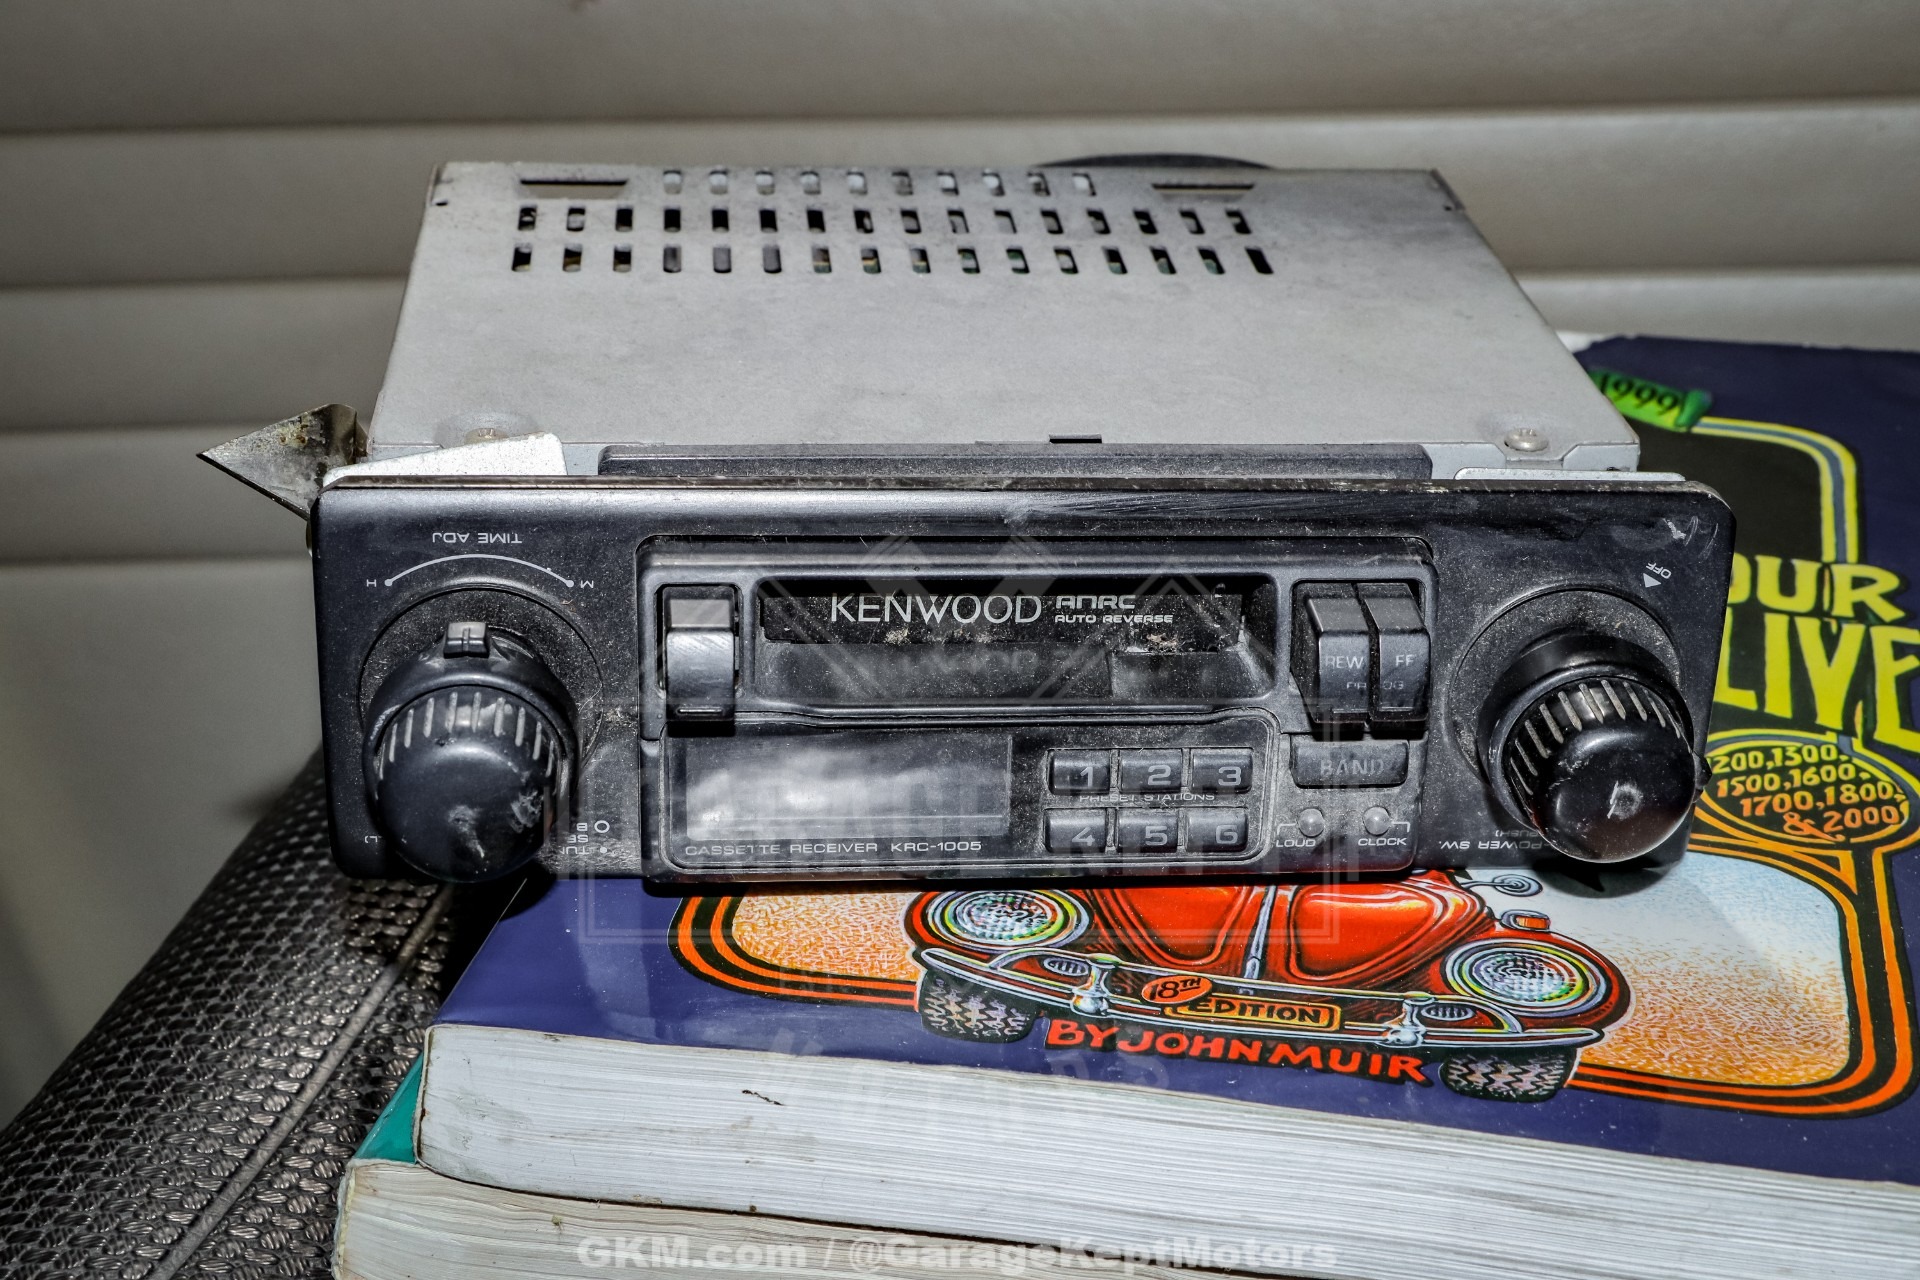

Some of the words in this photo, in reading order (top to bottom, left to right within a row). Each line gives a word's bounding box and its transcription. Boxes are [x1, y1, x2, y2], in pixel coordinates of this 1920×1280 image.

[431, 532, 471, 543] ADJ
[478, 532, 523, 544] TIME
[1645, 562, 1672, 579] OFF
[366, 578, 378, 588] H
[580, 579, 595, 589] M
[830, 593, 1043, 625] KENWOOD
[1054, 614, 1097, 624] AUTO
[1102, 614, 1174, 625] REVERSE
[1325, 655, 1364, 669] REW
[1395, 654, 1415, 667] FF
[1320, 759, 1385, 776] BAND
[1706, 743, 1850, 775] 200,1300,
[1080, 766, 1094, 788] 1
[1147, 764, 1172, 786] 2
[1218, 766, 1242, 787] 3
[1783, 811, 1846, 841] &
[1823, 805, 1900, 833] 2000
[1071, 826, 1096, 846] 4
[1145, 825, 1168, 846] 5
[1215, 824, 1239, 845] 6
[1358, 837, 1408, 847] CLOCK
[685, 844, 781, 856] CASSETTE
[790, 842, 878, 854] RECEIVER
[891, 841, 982, 852] KRC-1005
[1275, 839, 1316, 848] LOUD
[1439, 840, 1471, 850] SW.
[1190, 998, 1323, 1026] EDITION
[1046, 1018, 1119, 1048] BY
[1117, 1029, 1263, 1063] JOHN
[1267, 1042, 1427, 1082] MUIR
